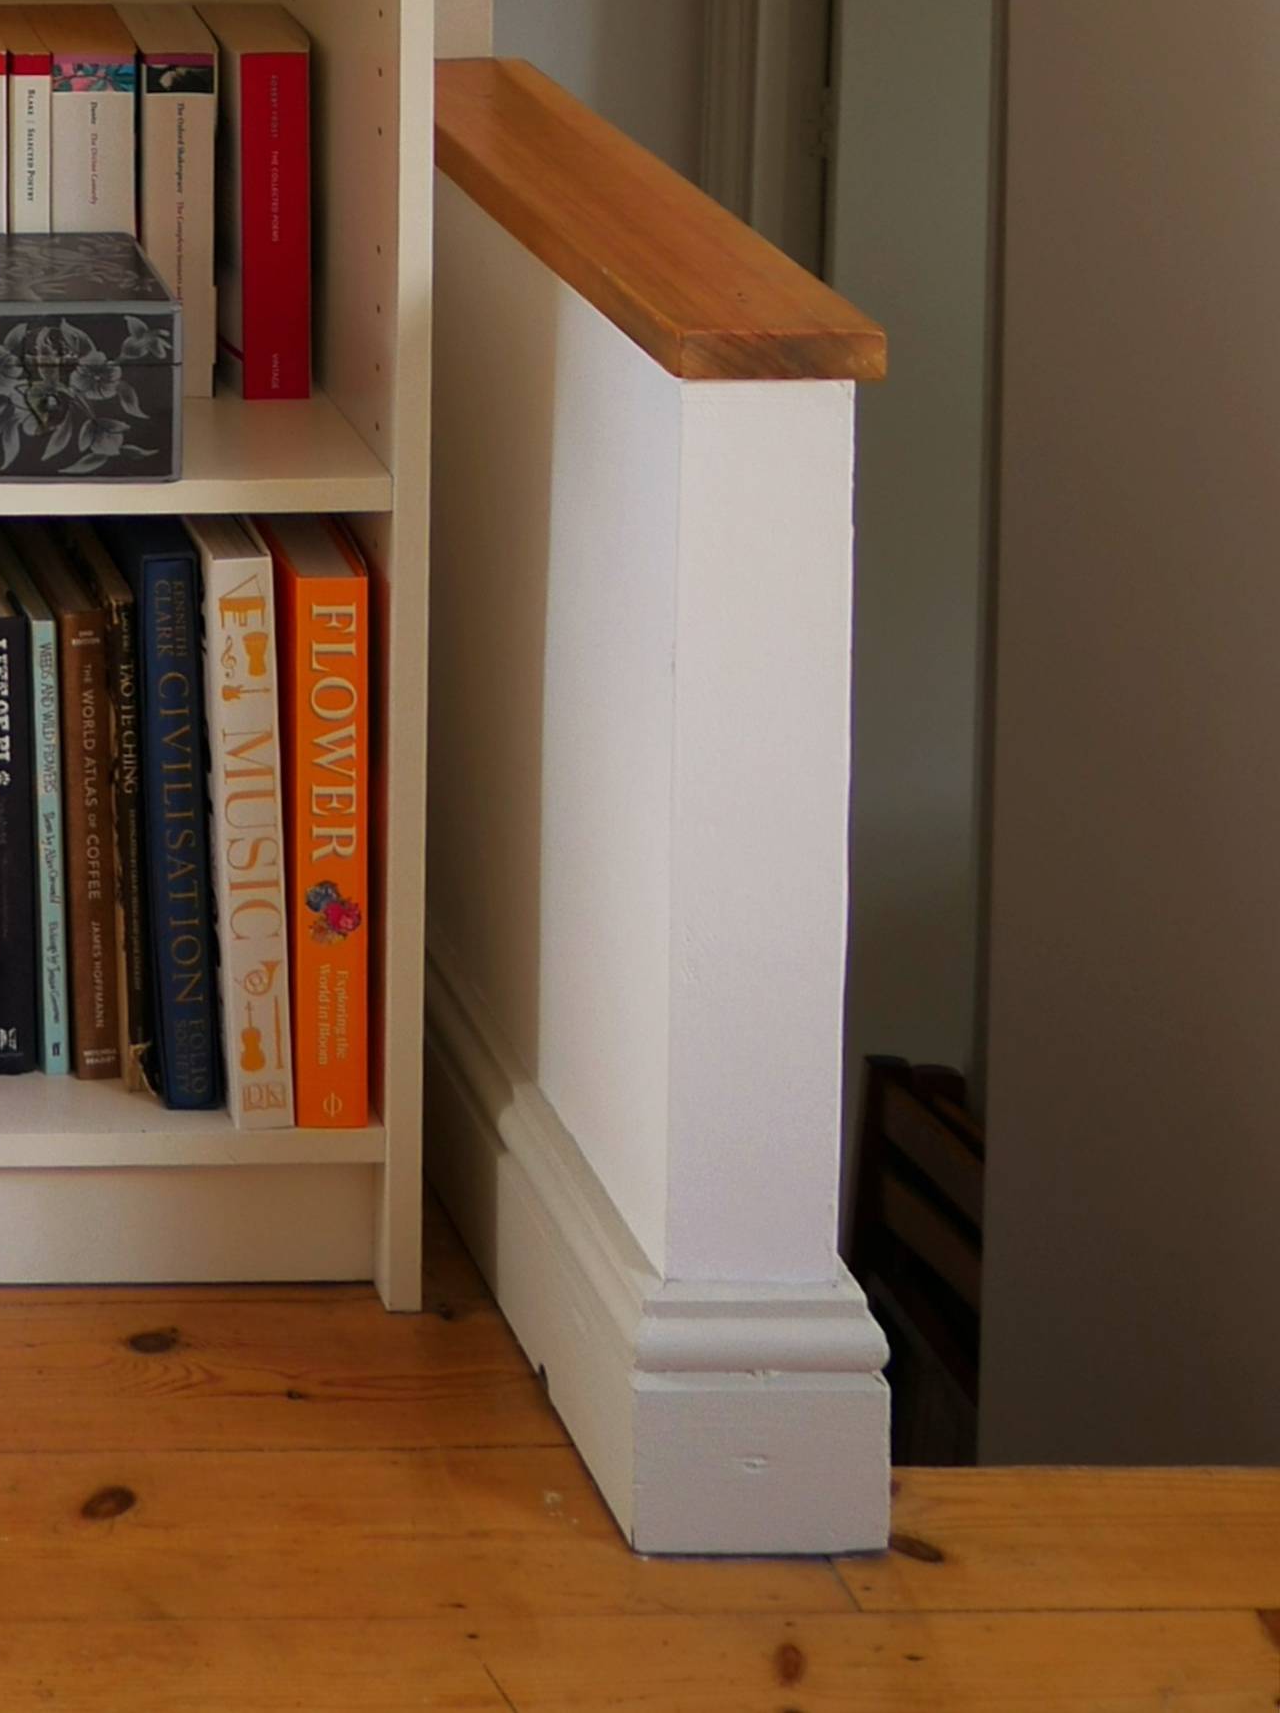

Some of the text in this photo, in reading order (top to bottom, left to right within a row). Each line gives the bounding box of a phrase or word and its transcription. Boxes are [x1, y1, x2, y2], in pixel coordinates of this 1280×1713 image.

[270, 353, 278, 388] VINTAGE
[119, 664, 134, 698] TAO
[308, 601, 358, 863] FLOWER
[81, 689, 100, 900] WORLD ATLAS OF COFFEE
[120, 732, 137, 794] CHING
[155, 672, 202, 1003] CIVILISATION
[222, 729, 280, 943] MUSIC
[89, 920, 104, 1028] JAMES HOFFMANN
[315, 963, 330, 1065] World in Bloom
[330, 969, 348, 1059] Exploring the
